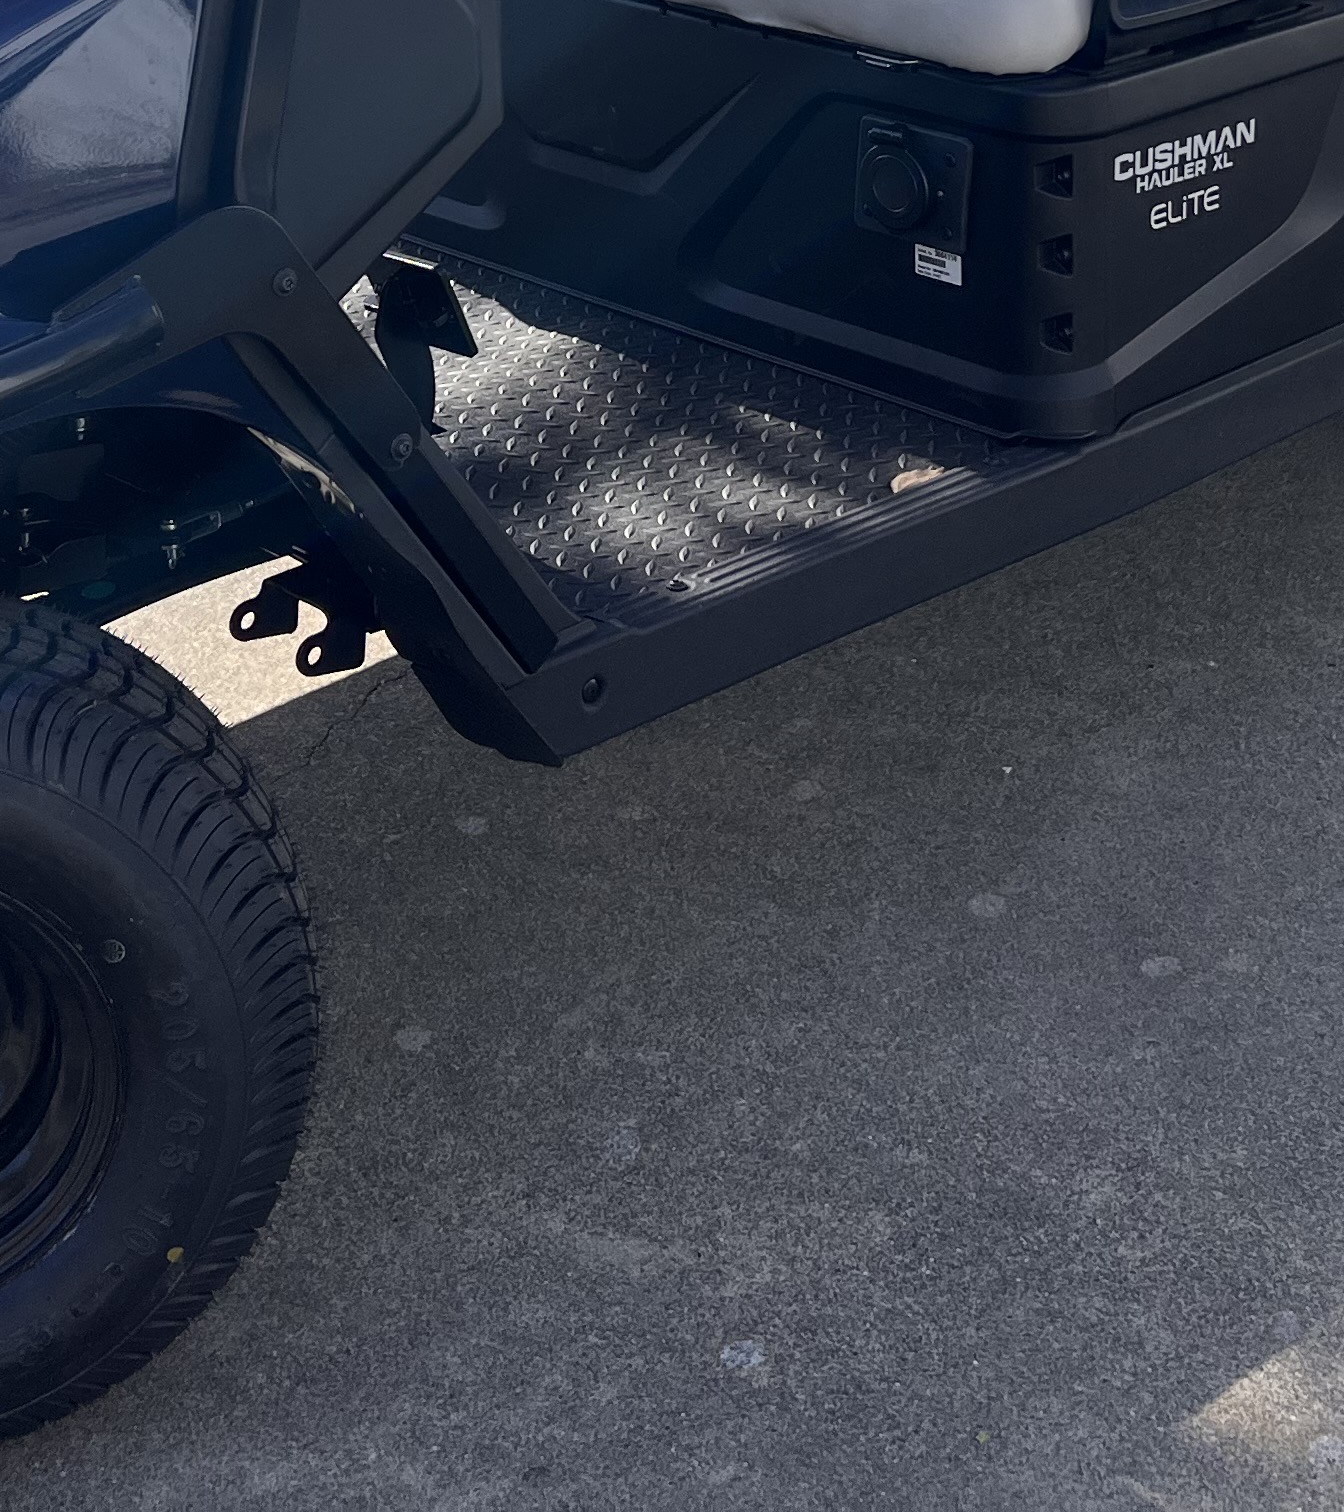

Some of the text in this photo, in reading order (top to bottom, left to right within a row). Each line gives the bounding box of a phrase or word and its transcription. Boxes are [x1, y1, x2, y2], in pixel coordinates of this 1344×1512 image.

[1113, 118, 1256, 181] CUSHMAN
[1135, 151, 1233, 193] HAULER XL
[124, 980, 208, 1255] 205/65-10
